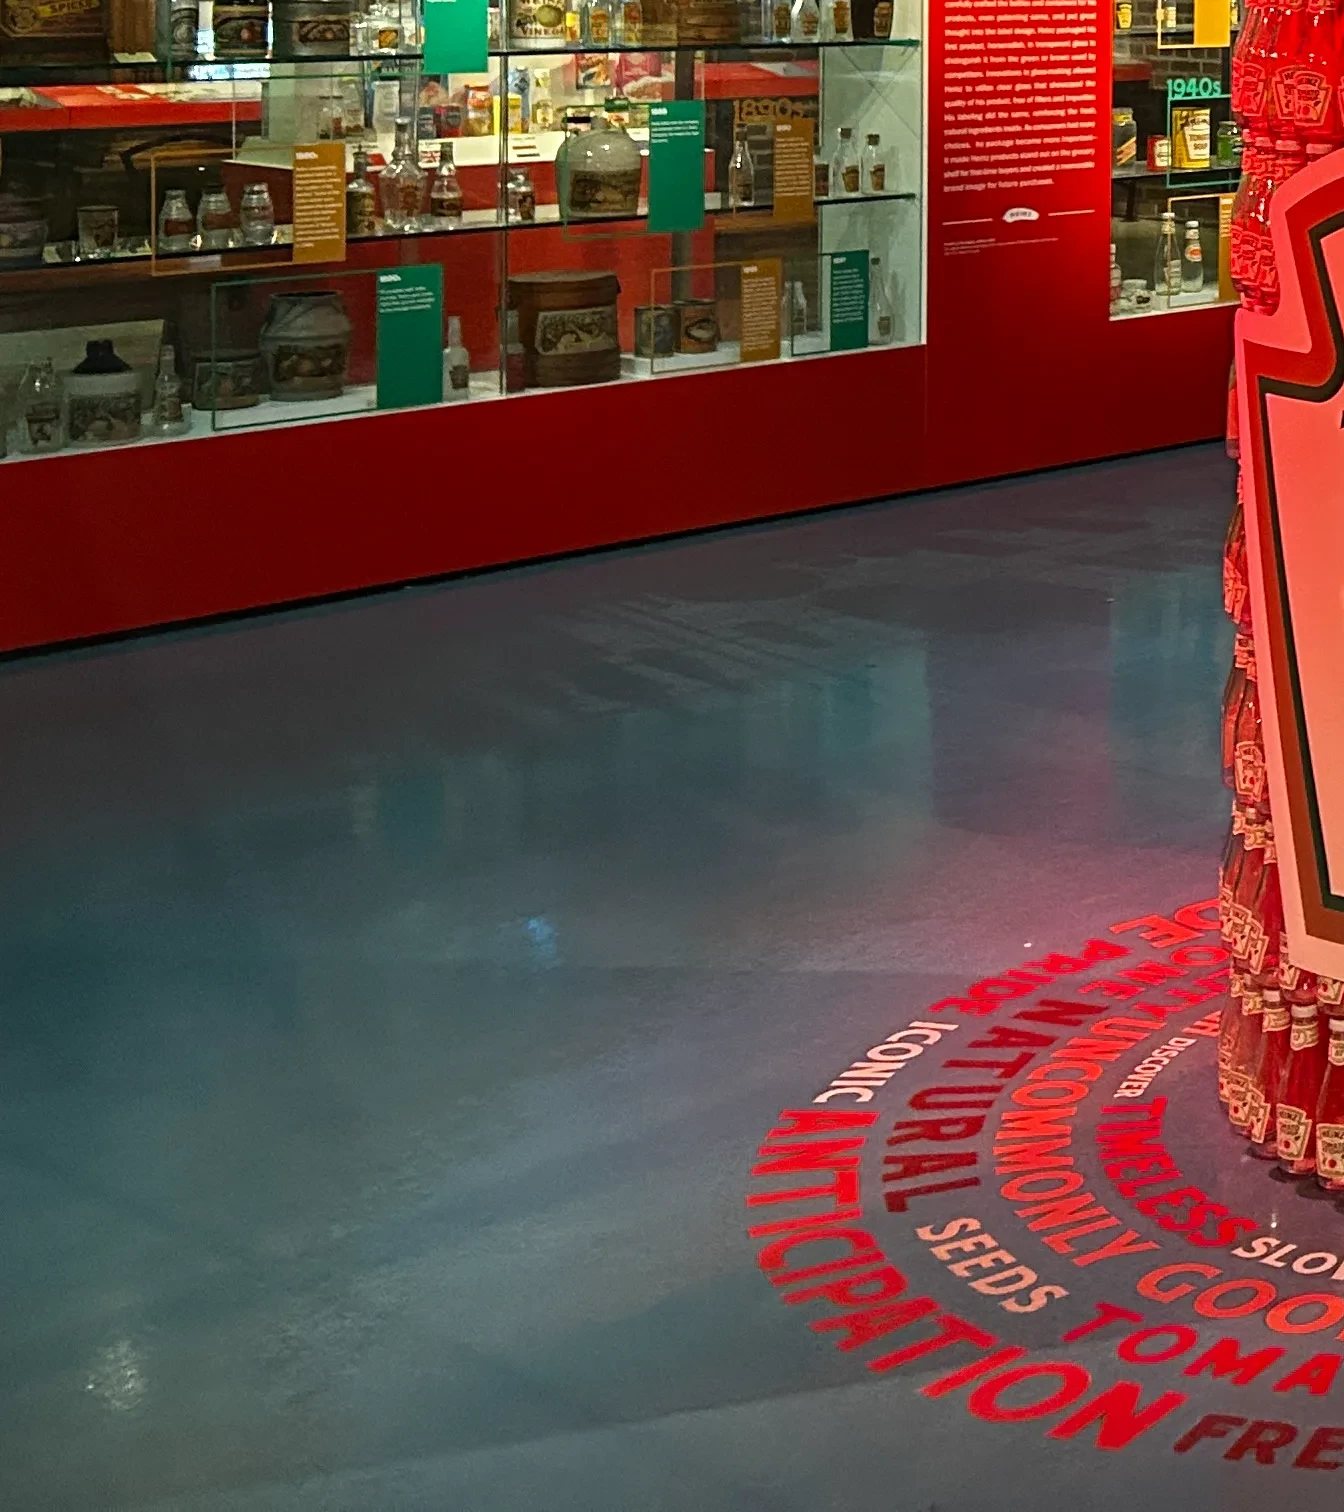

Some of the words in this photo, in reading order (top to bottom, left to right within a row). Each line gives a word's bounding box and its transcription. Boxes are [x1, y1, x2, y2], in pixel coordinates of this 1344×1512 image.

[1166, 78, 1221, 99] 1940s
[813, 1021, 959, 1104] ICONIC
[882, 999, 1111, 1213] NATURAL
[1113, 1037, 1198, 1099] DISCOVER
[993, 1016, 1167, 1267] UNCOMMONLY
[1096, 1095, 1260, 1246] TIMELESS
[745, 1107, 1188, 1451] ANTICIPATION
[915, 1217, 1068, 1313] SEEDS
